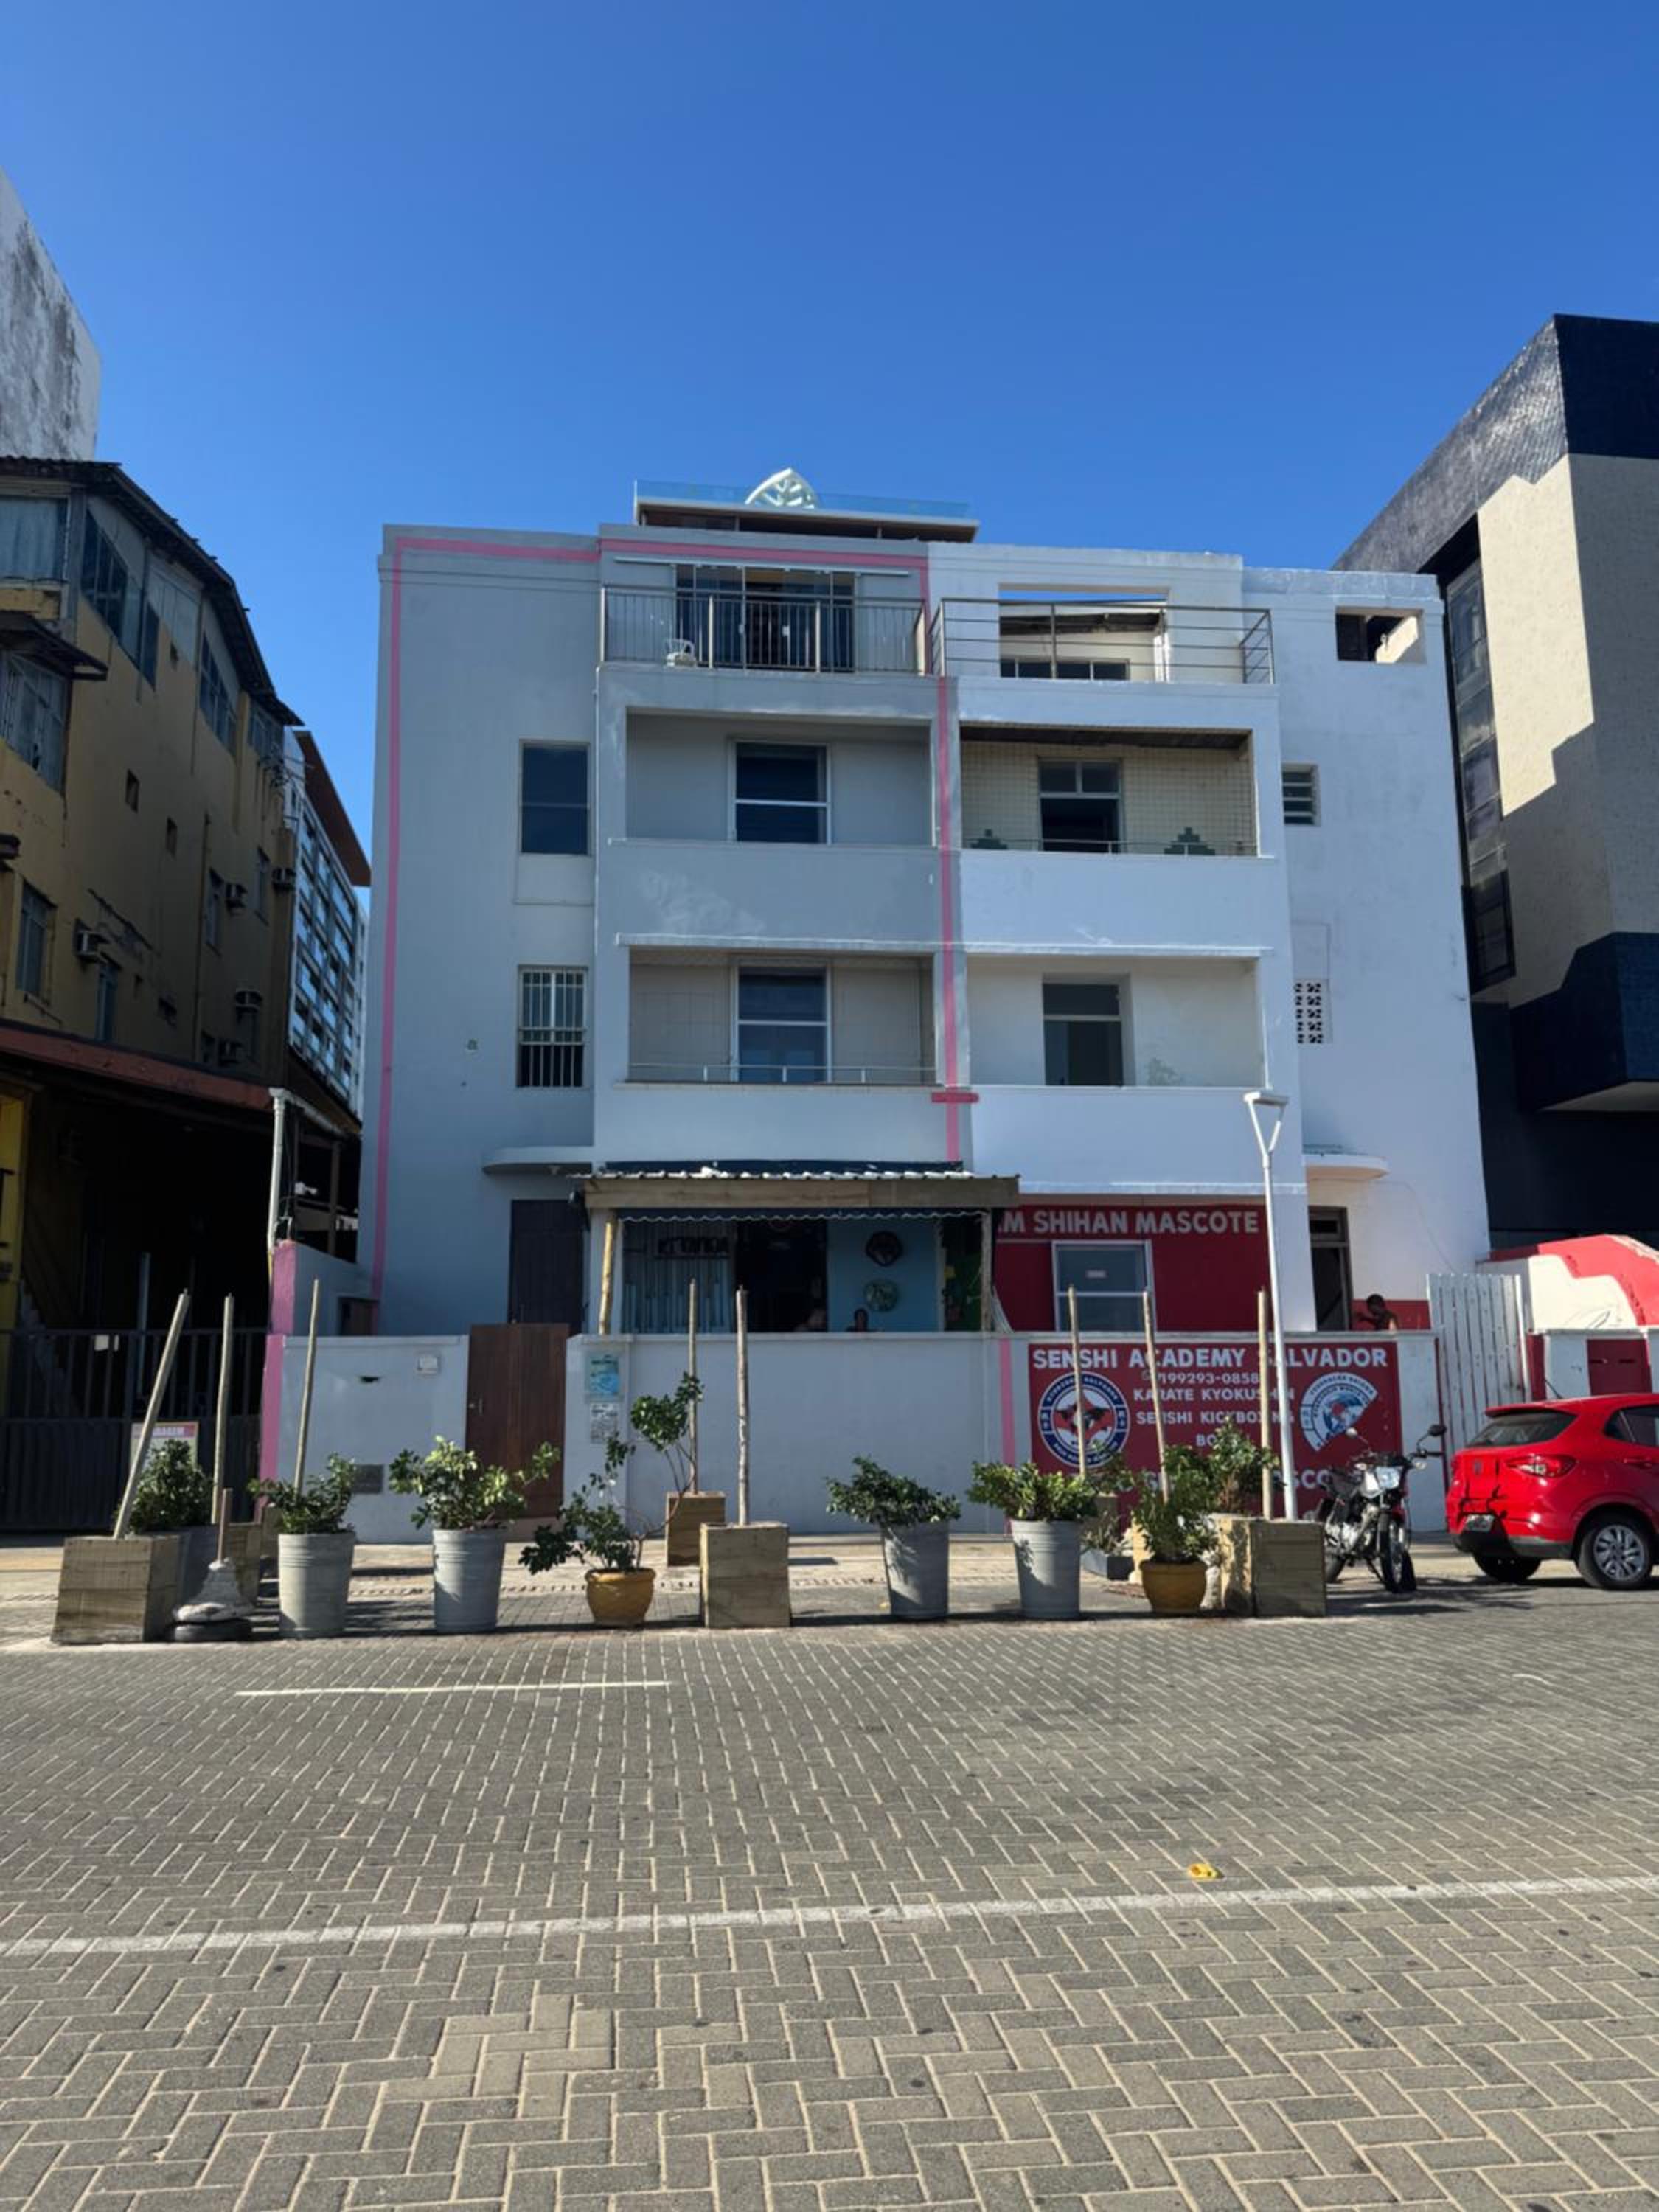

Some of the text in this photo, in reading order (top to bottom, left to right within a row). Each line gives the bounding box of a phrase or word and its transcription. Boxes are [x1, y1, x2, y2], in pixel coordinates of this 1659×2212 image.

[997, 1210, 1259, 1234] M SHIHAN MASCOTE
[1032, 1349, 1118, 1369] SENSHI
[1259, 1347, 1388, 1368] LVADOR
